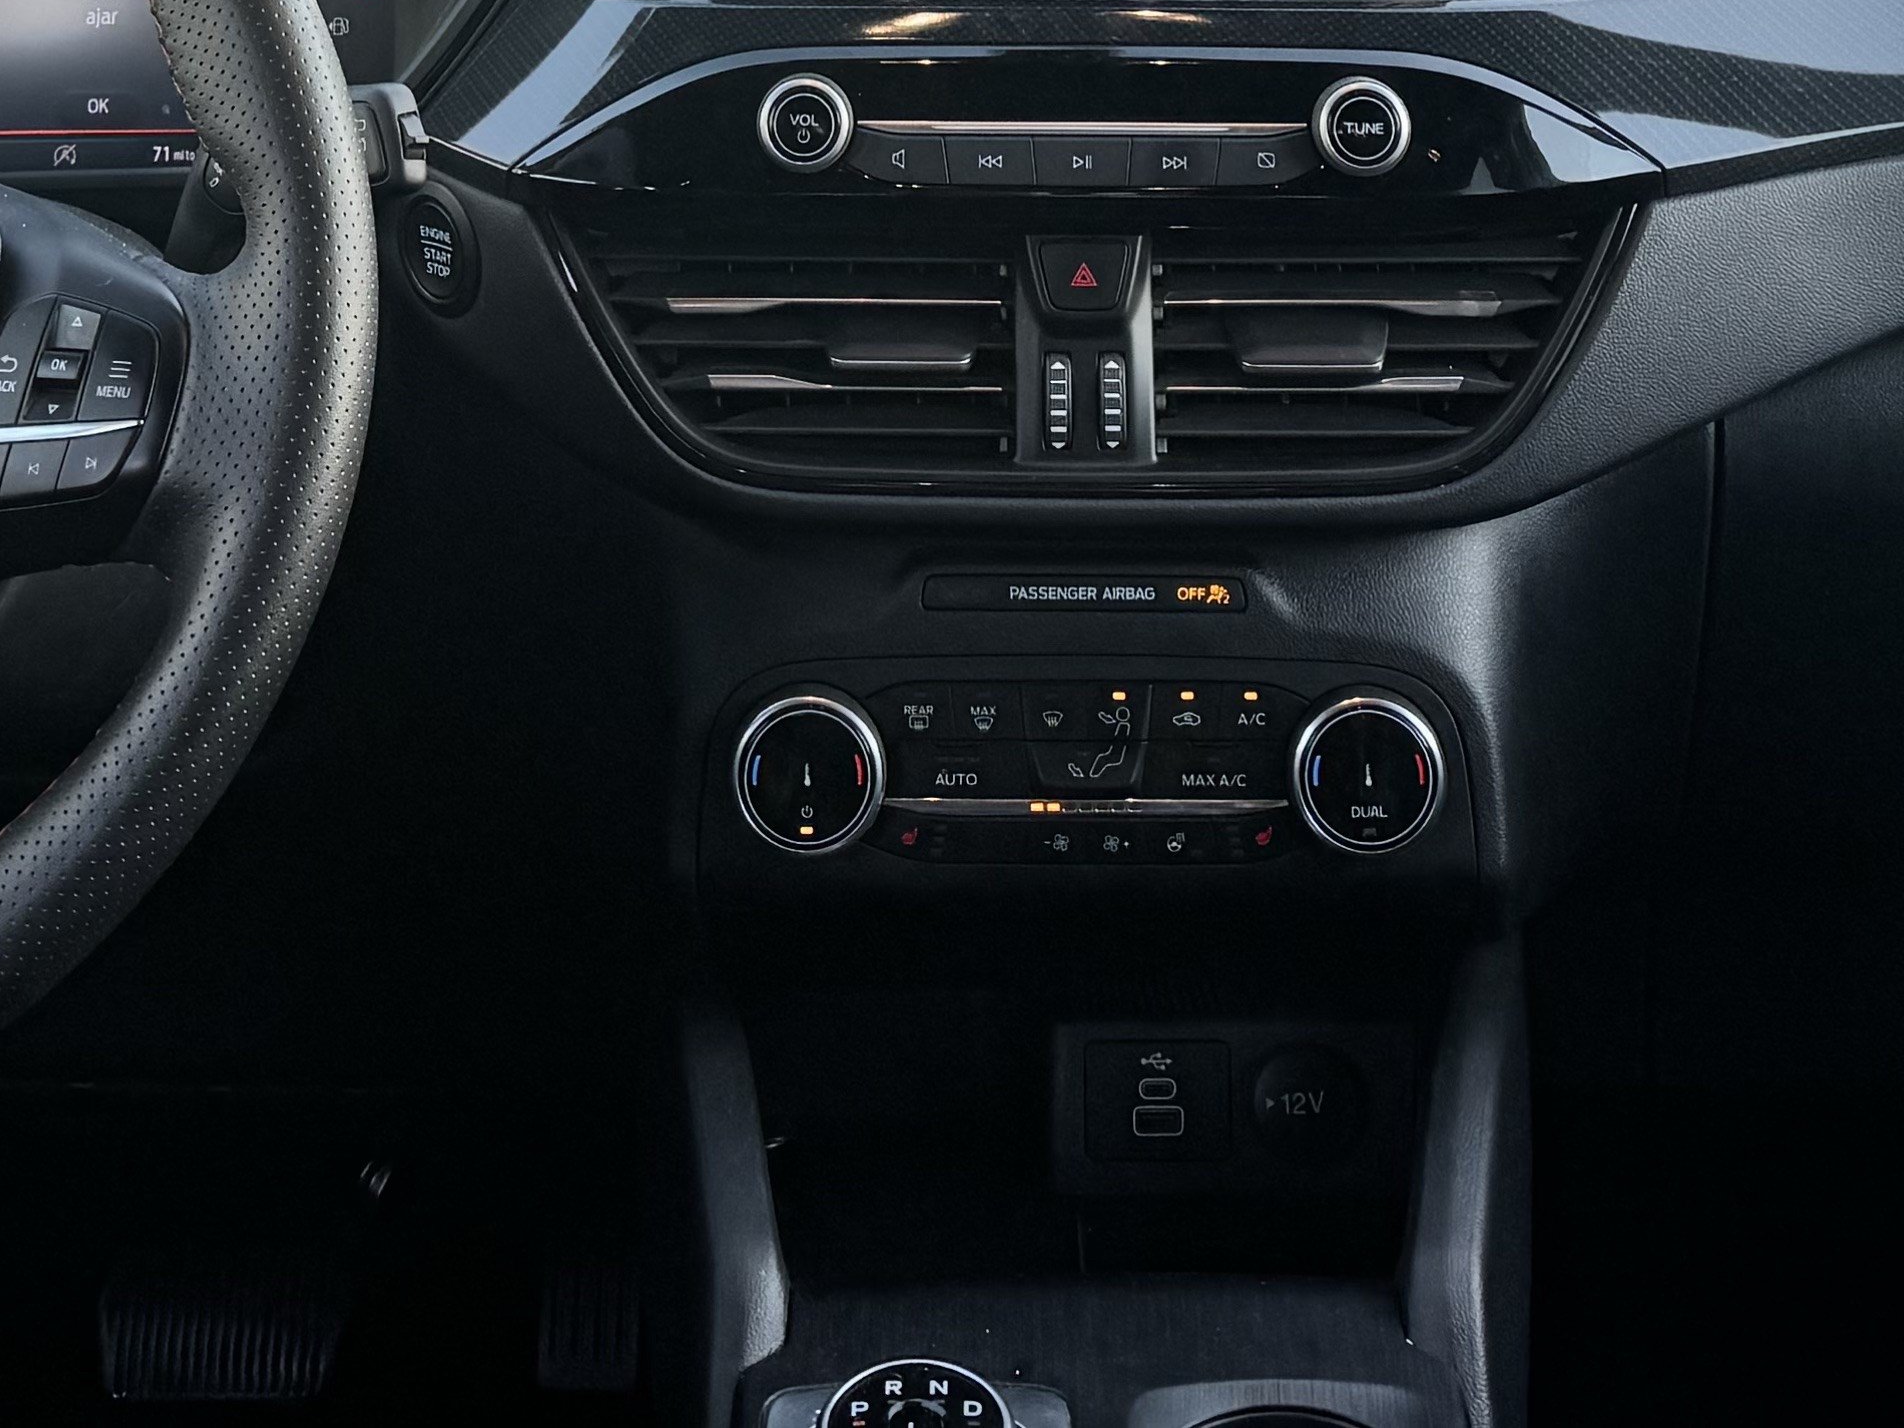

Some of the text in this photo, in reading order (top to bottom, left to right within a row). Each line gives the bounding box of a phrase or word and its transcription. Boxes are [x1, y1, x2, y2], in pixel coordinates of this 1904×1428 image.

[85, 6, 118, 27] ajar
[86, 98, 110, 115] OK
[789, 113, 819, 128] VOL
[1343, 121, 1384, 136] TUNE
[152, 145, 170, 163] 71
[419, 224, 452, 245] ENGINE
[423, 246, 453, 266] START
[425, 261, 451, 278] STOP
[50, 357, 69, 372] OK
[95, 385, 132, 400] MENU
[1009, 585, 1206, 602] PASSENGER AIRBAG OFF
[902, 705, 935, 717] REAR
[969, 705, 997, 717] MAX
[1236, 713, 1267, 728] A/C
[934, 772, 979, 789] AUTO
[1181, 773, 1249, 789] MAX A/C
[1350, 805, 1388, 821] DUAL
[1280, 1089, 1324, 1115] 12V
[884, 1379, 903, 1397] R
[928, 1379, 949, 1397] N
[849, 1400, 870, 1418] P
[962, 1399, 984, 1417] D
